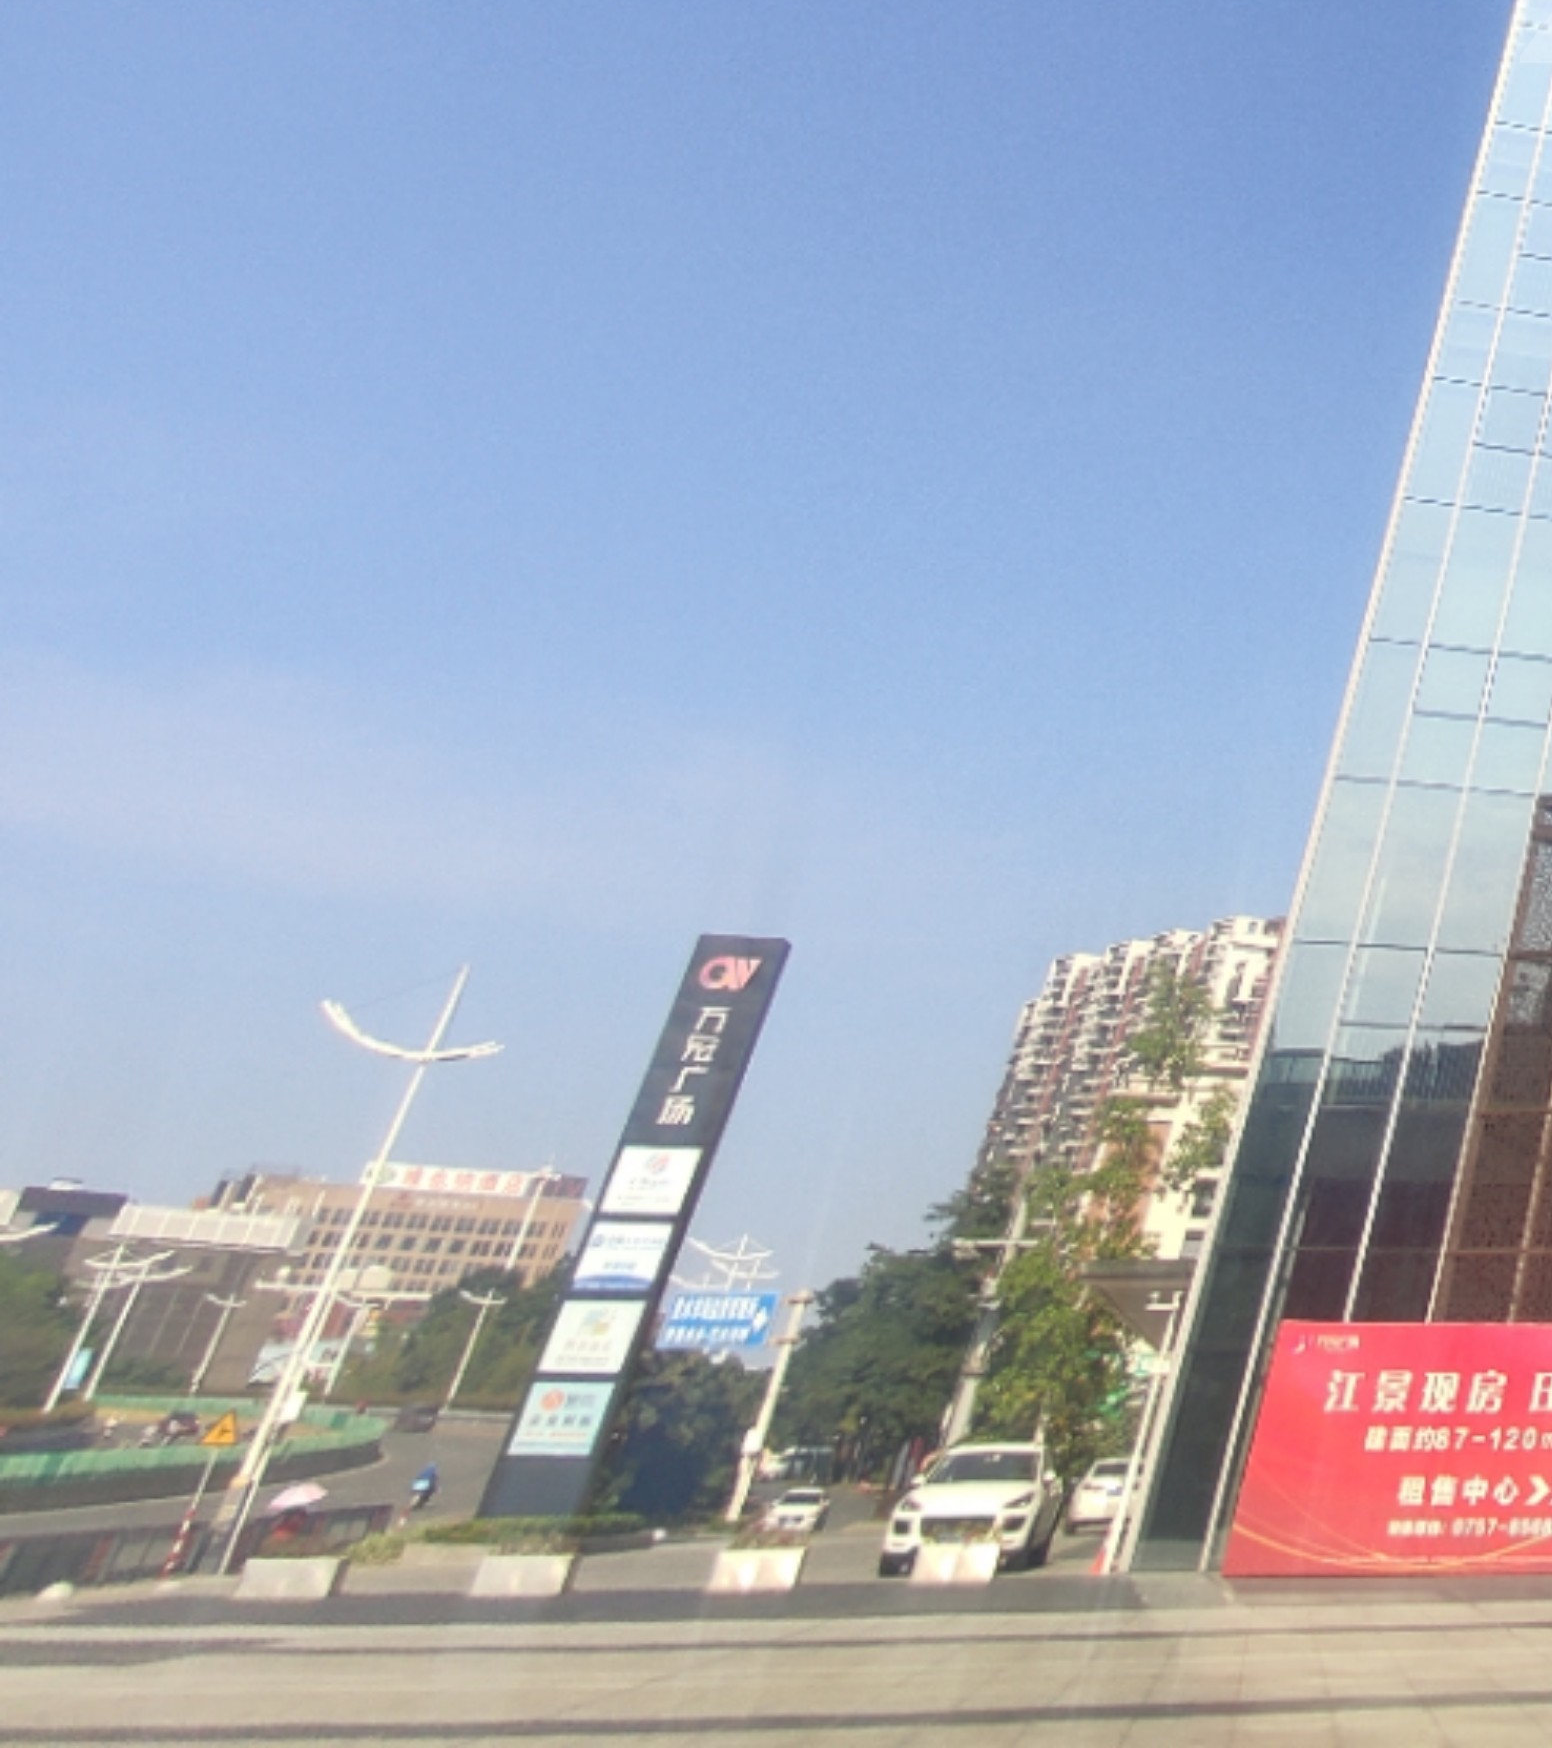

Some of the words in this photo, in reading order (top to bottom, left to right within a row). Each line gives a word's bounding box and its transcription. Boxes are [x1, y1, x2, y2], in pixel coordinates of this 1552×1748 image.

[655, 1006, 732, 1126] 万冠广场
[1323, 1369, 1508, 1415] 江景现房
[1396, 1473, 1520, 1507] 租售中心
